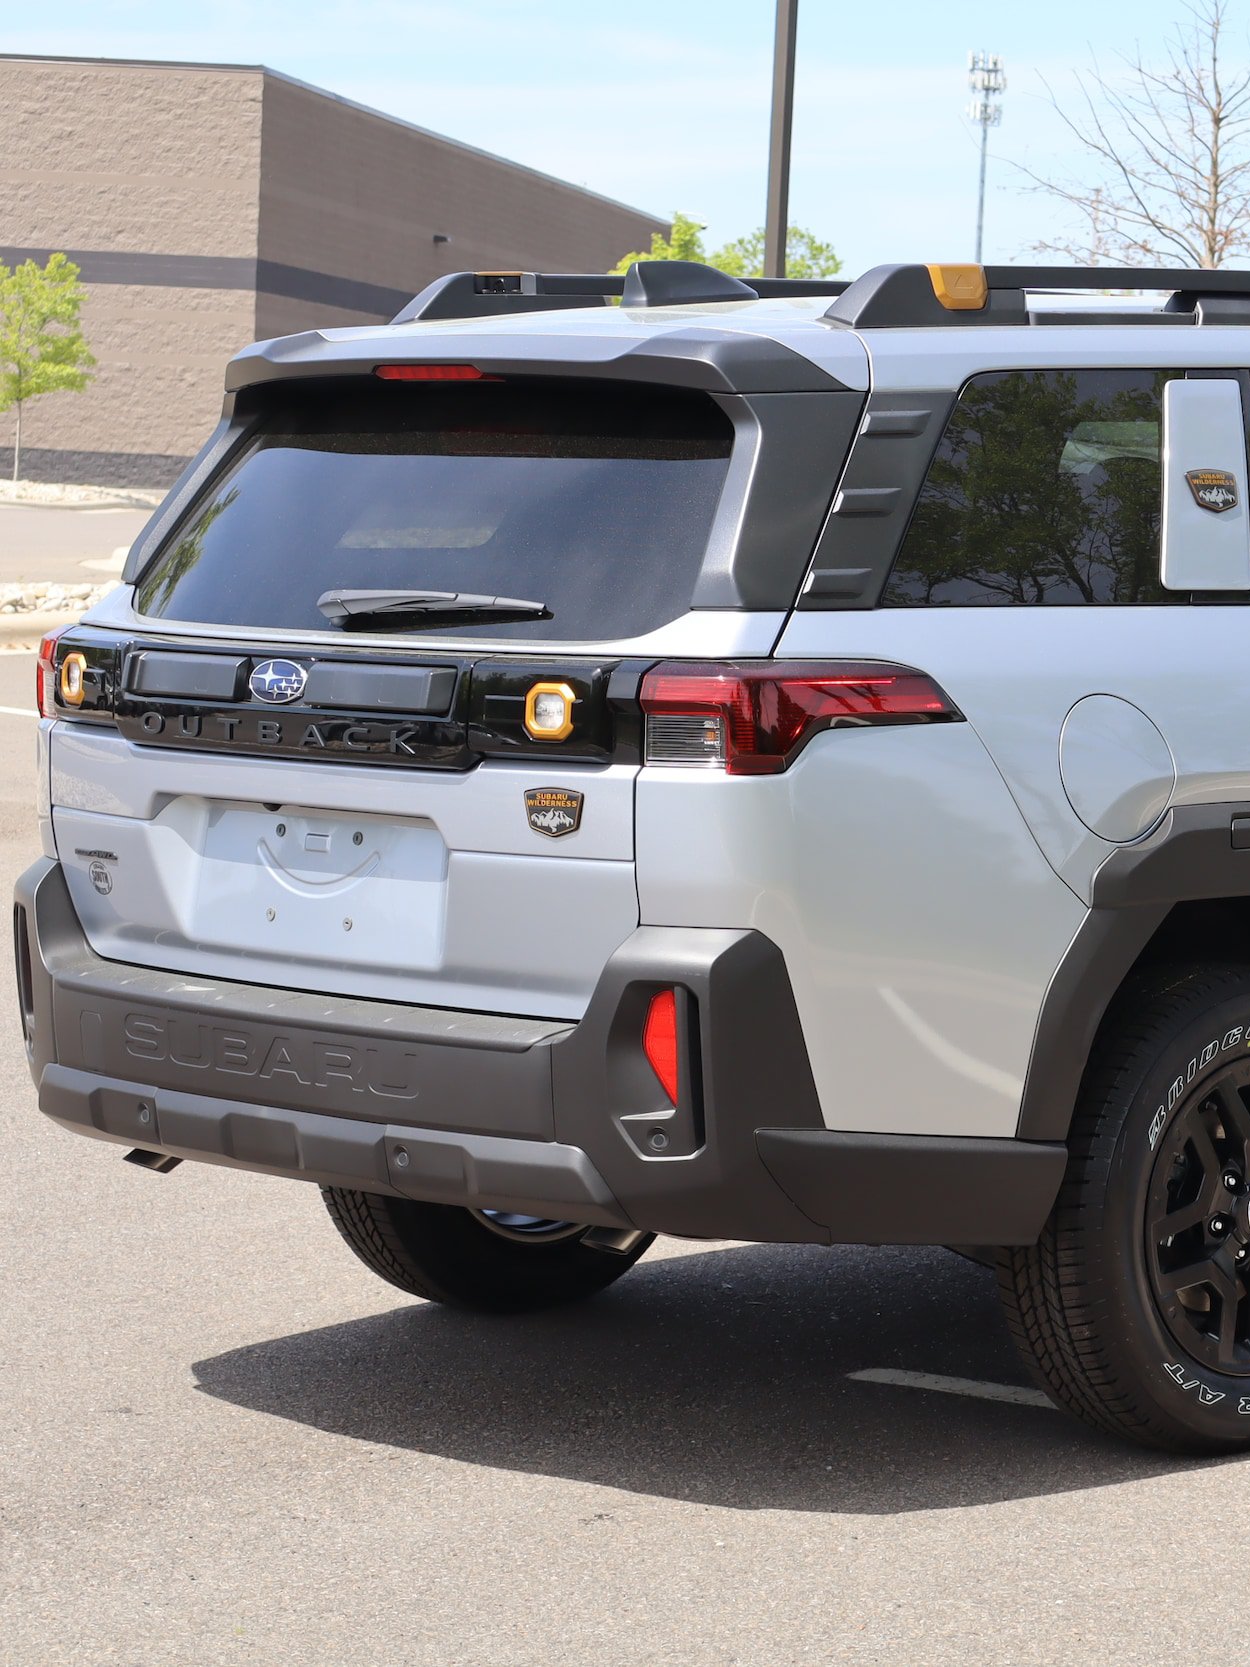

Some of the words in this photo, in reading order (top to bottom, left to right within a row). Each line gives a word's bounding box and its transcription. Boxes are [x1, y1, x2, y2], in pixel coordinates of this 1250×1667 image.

[140, 711, 416, 755] OUTBACK
[527, 799, 577, 807] WILDERNESS
[124, 1012, 419, 1099] SUBARU
[1162, 1361, 1226, 1405] A/T
